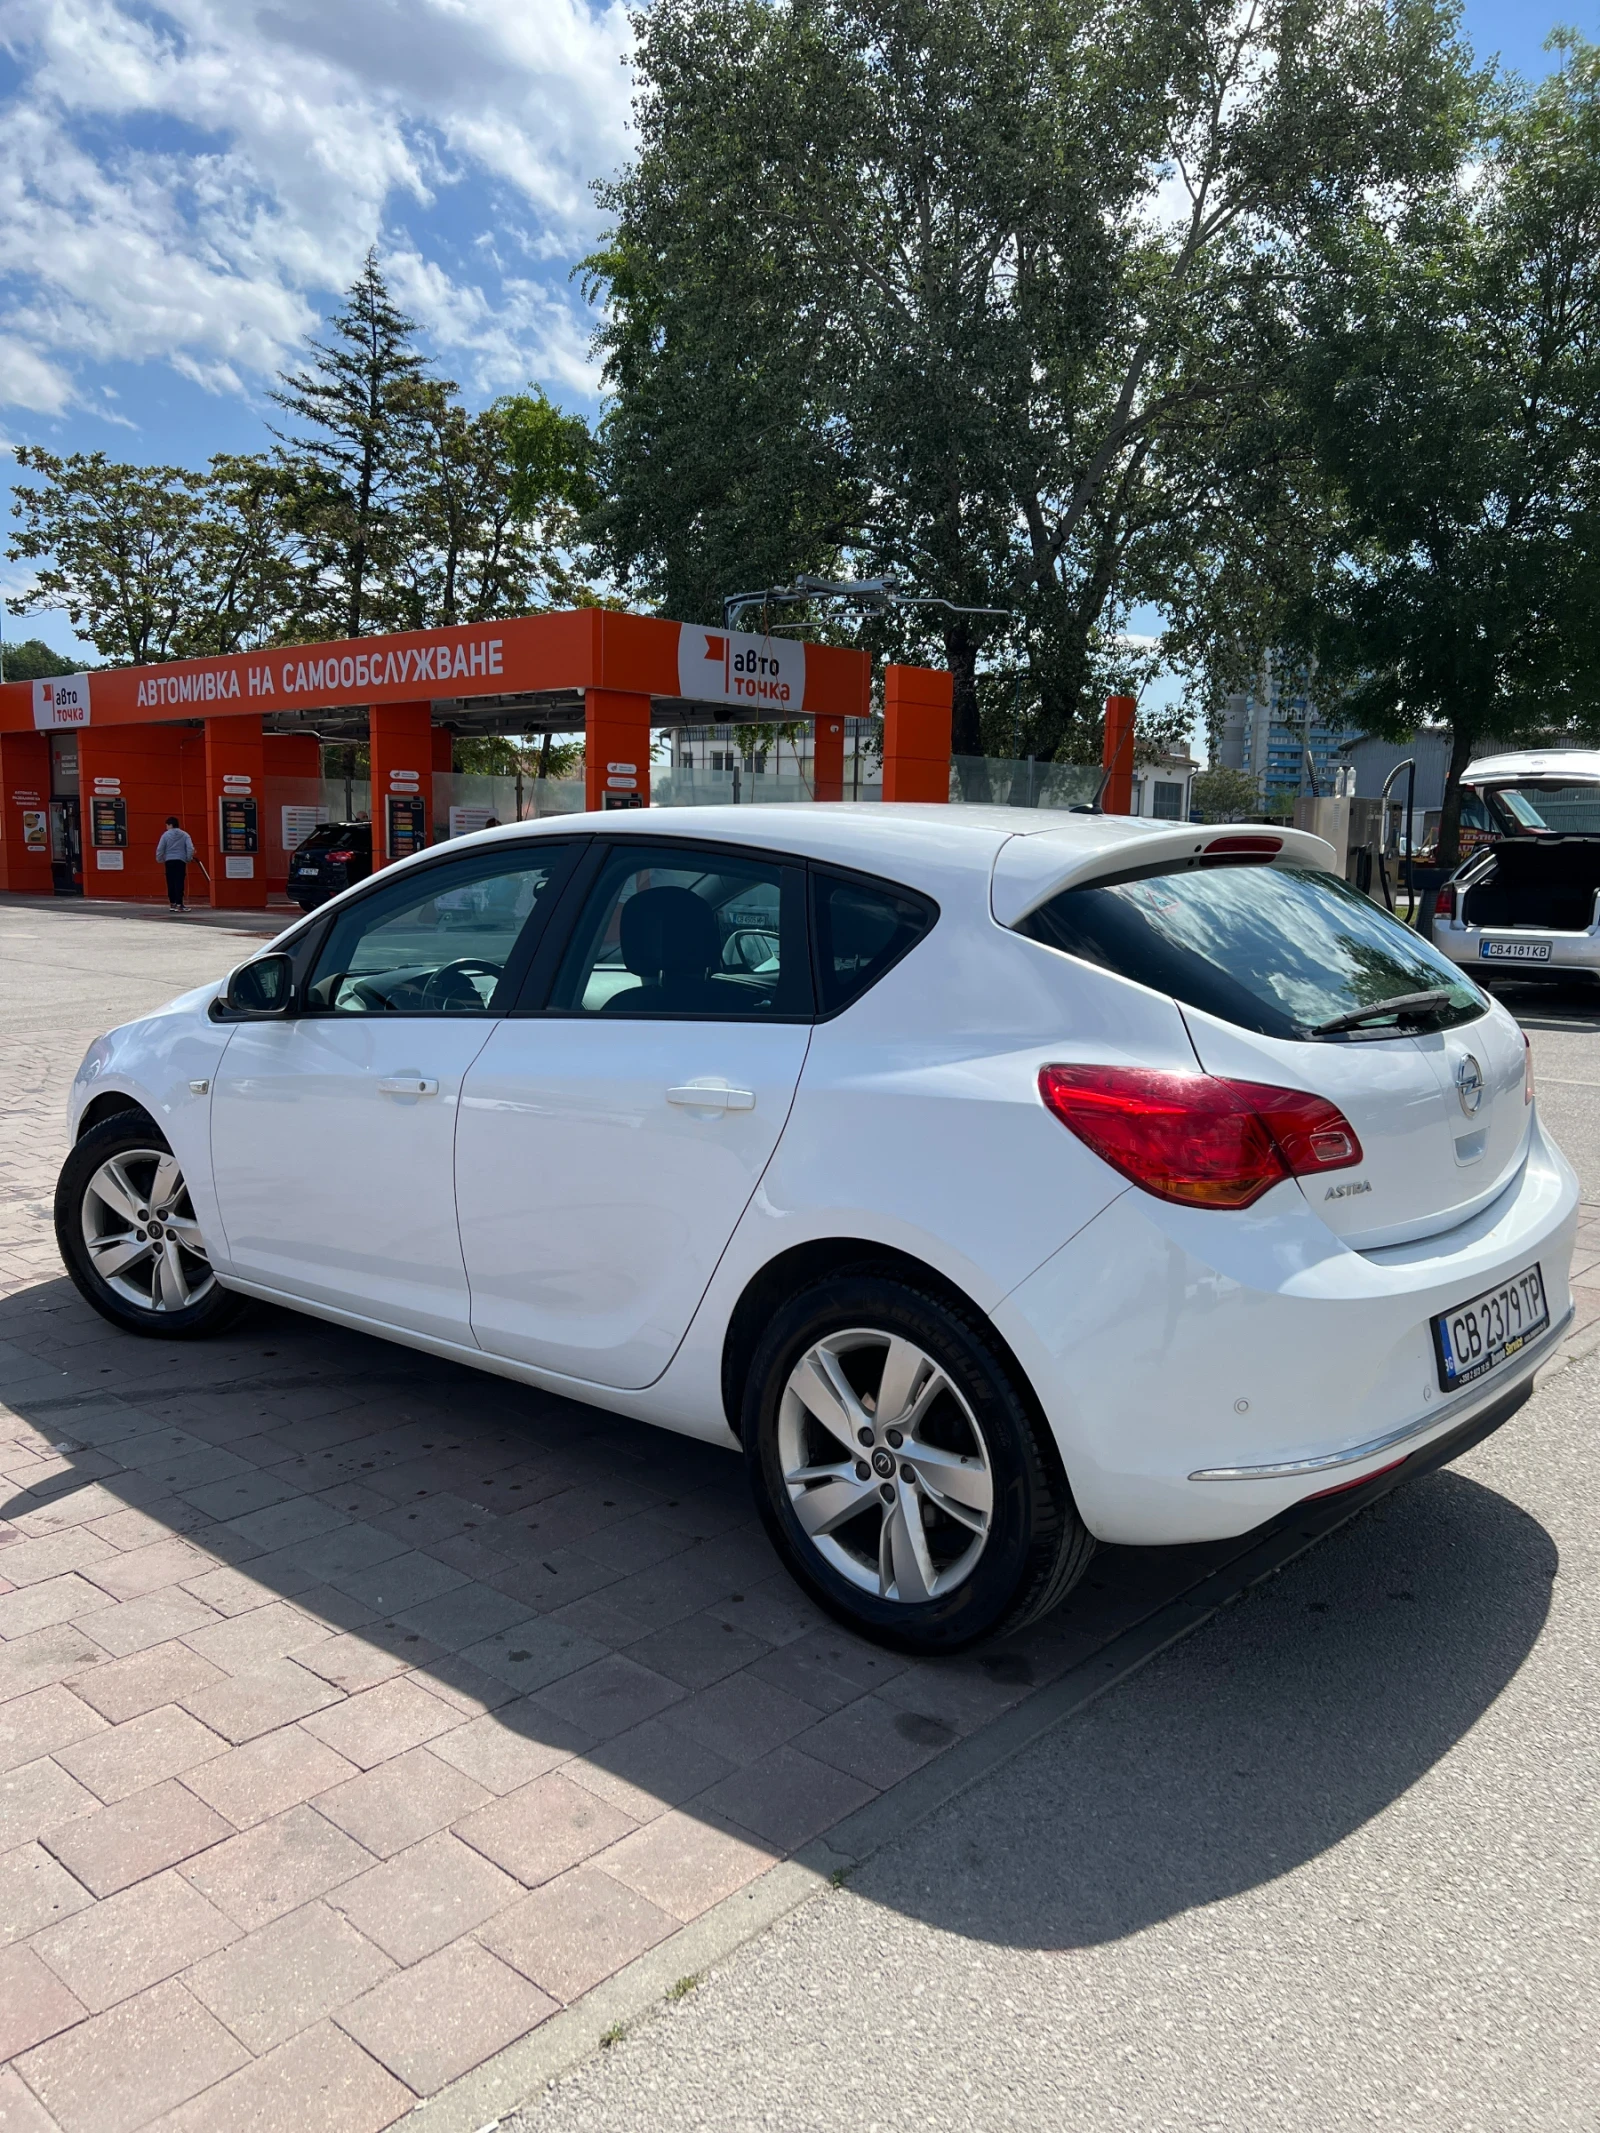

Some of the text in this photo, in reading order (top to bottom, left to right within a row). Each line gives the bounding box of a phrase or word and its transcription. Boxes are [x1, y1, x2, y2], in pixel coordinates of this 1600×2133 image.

[137, 639, 503, 707] АВТОМИВКА НА САМООБСЛУЖВАНЕ
[734, 677, 790, 701] точка
[57, 707, 84, 722] точка
[1505, 945, 1530, 956] 4181
[1532, 946, 1547, 957] KB
[1324, 1180, 1372, 1201] ASTRA
[1453, 1311, 1482, 1364] CB
[1481, 1286, 1522, 1348] 2379
[1520, 1273, 1540, 1320] TP
[1505, 1337, 1523, 1355] Service
